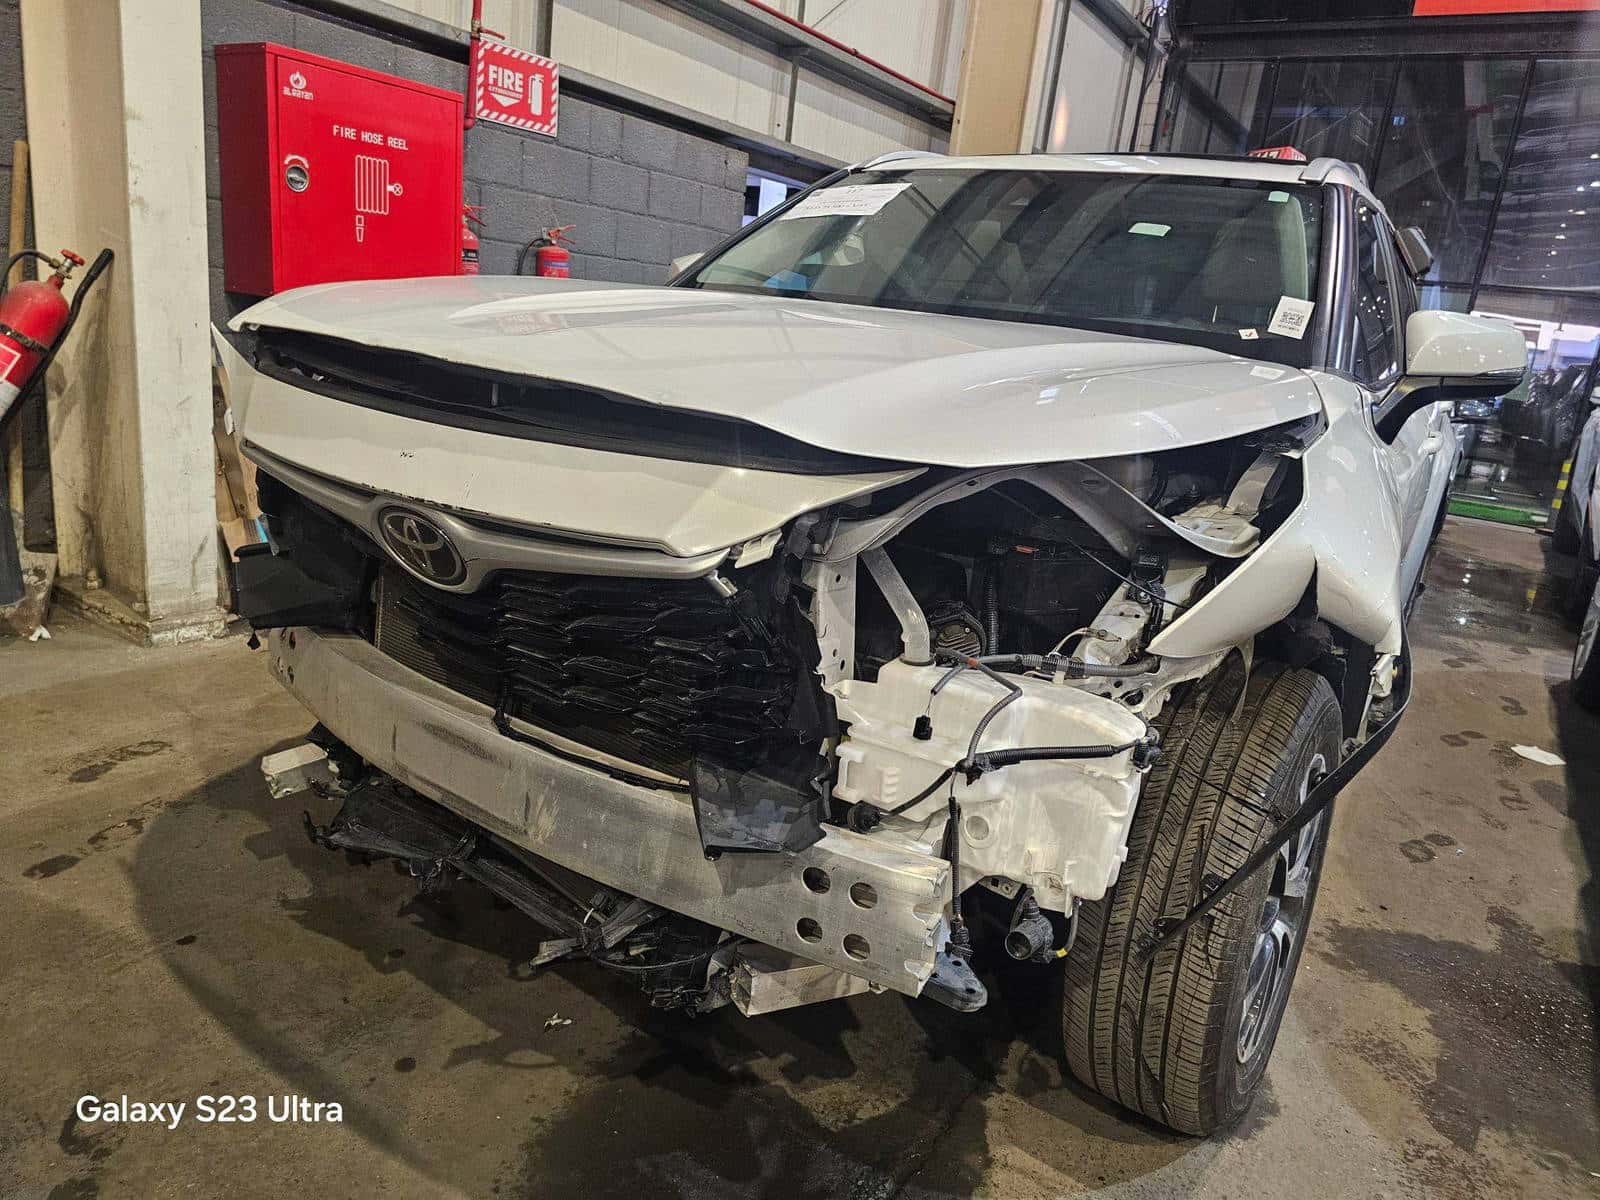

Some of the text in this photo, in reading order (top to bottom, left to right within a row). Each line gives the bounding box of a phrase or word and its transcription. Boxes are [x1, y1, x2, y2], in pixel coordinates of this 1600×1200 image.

[488, 64, 524, 93] FIRE
[332, 124, 409, 151] FIRE HOSE REEL
